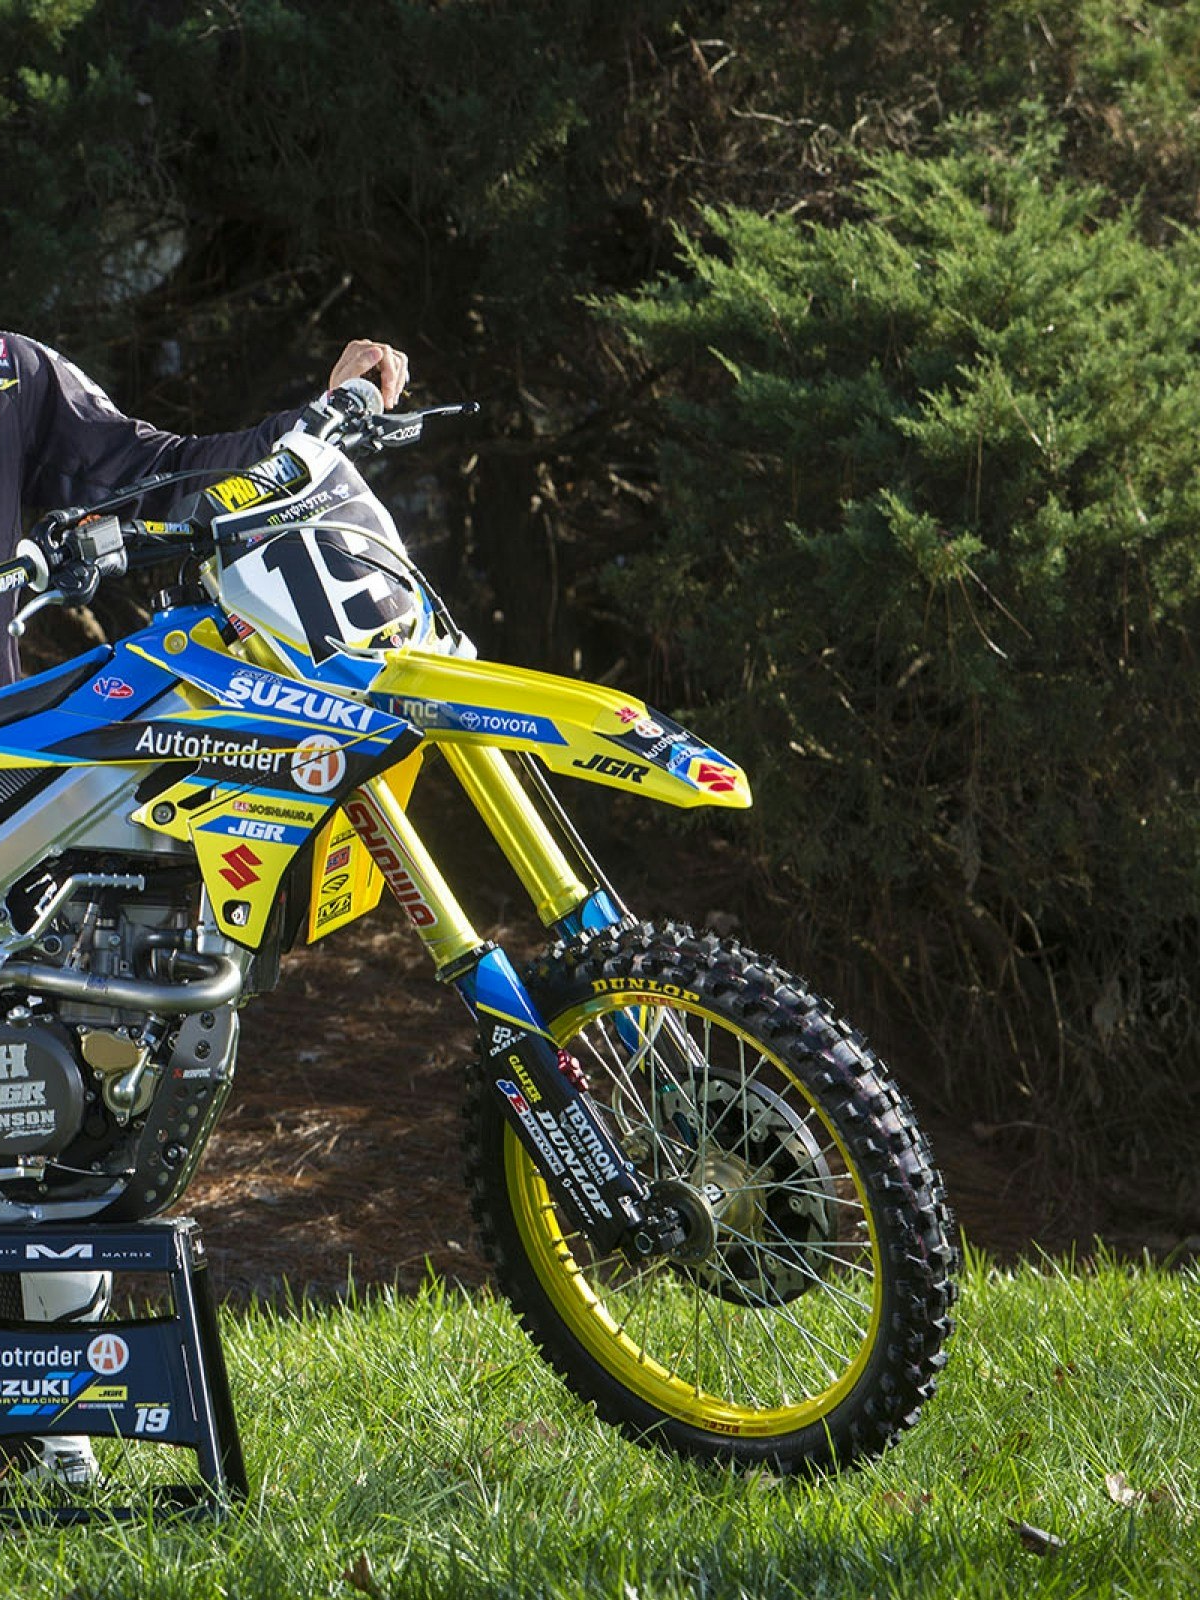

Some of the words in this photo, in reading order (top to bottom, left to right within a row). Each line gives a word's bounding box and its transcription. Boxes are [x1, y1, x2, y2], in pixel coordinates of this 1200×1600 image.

[228, 676, 375, 733] SUZUKI
[479, 714, 539, 736] TOYOTA
[135, 726, 287, 774] Autotrader
[572, 754, 651, 785] JGR
[227, 819, 286, 842] JGR
[590, 977, 701, 1003] DUNLOP
[565, 1099, 620, 1182] TEXTRON
[535, 1109, 613, 1219] DUNLOP
[21, 1396, 70, 1406] RACING
[134, 1407, 171, 1433] 19
